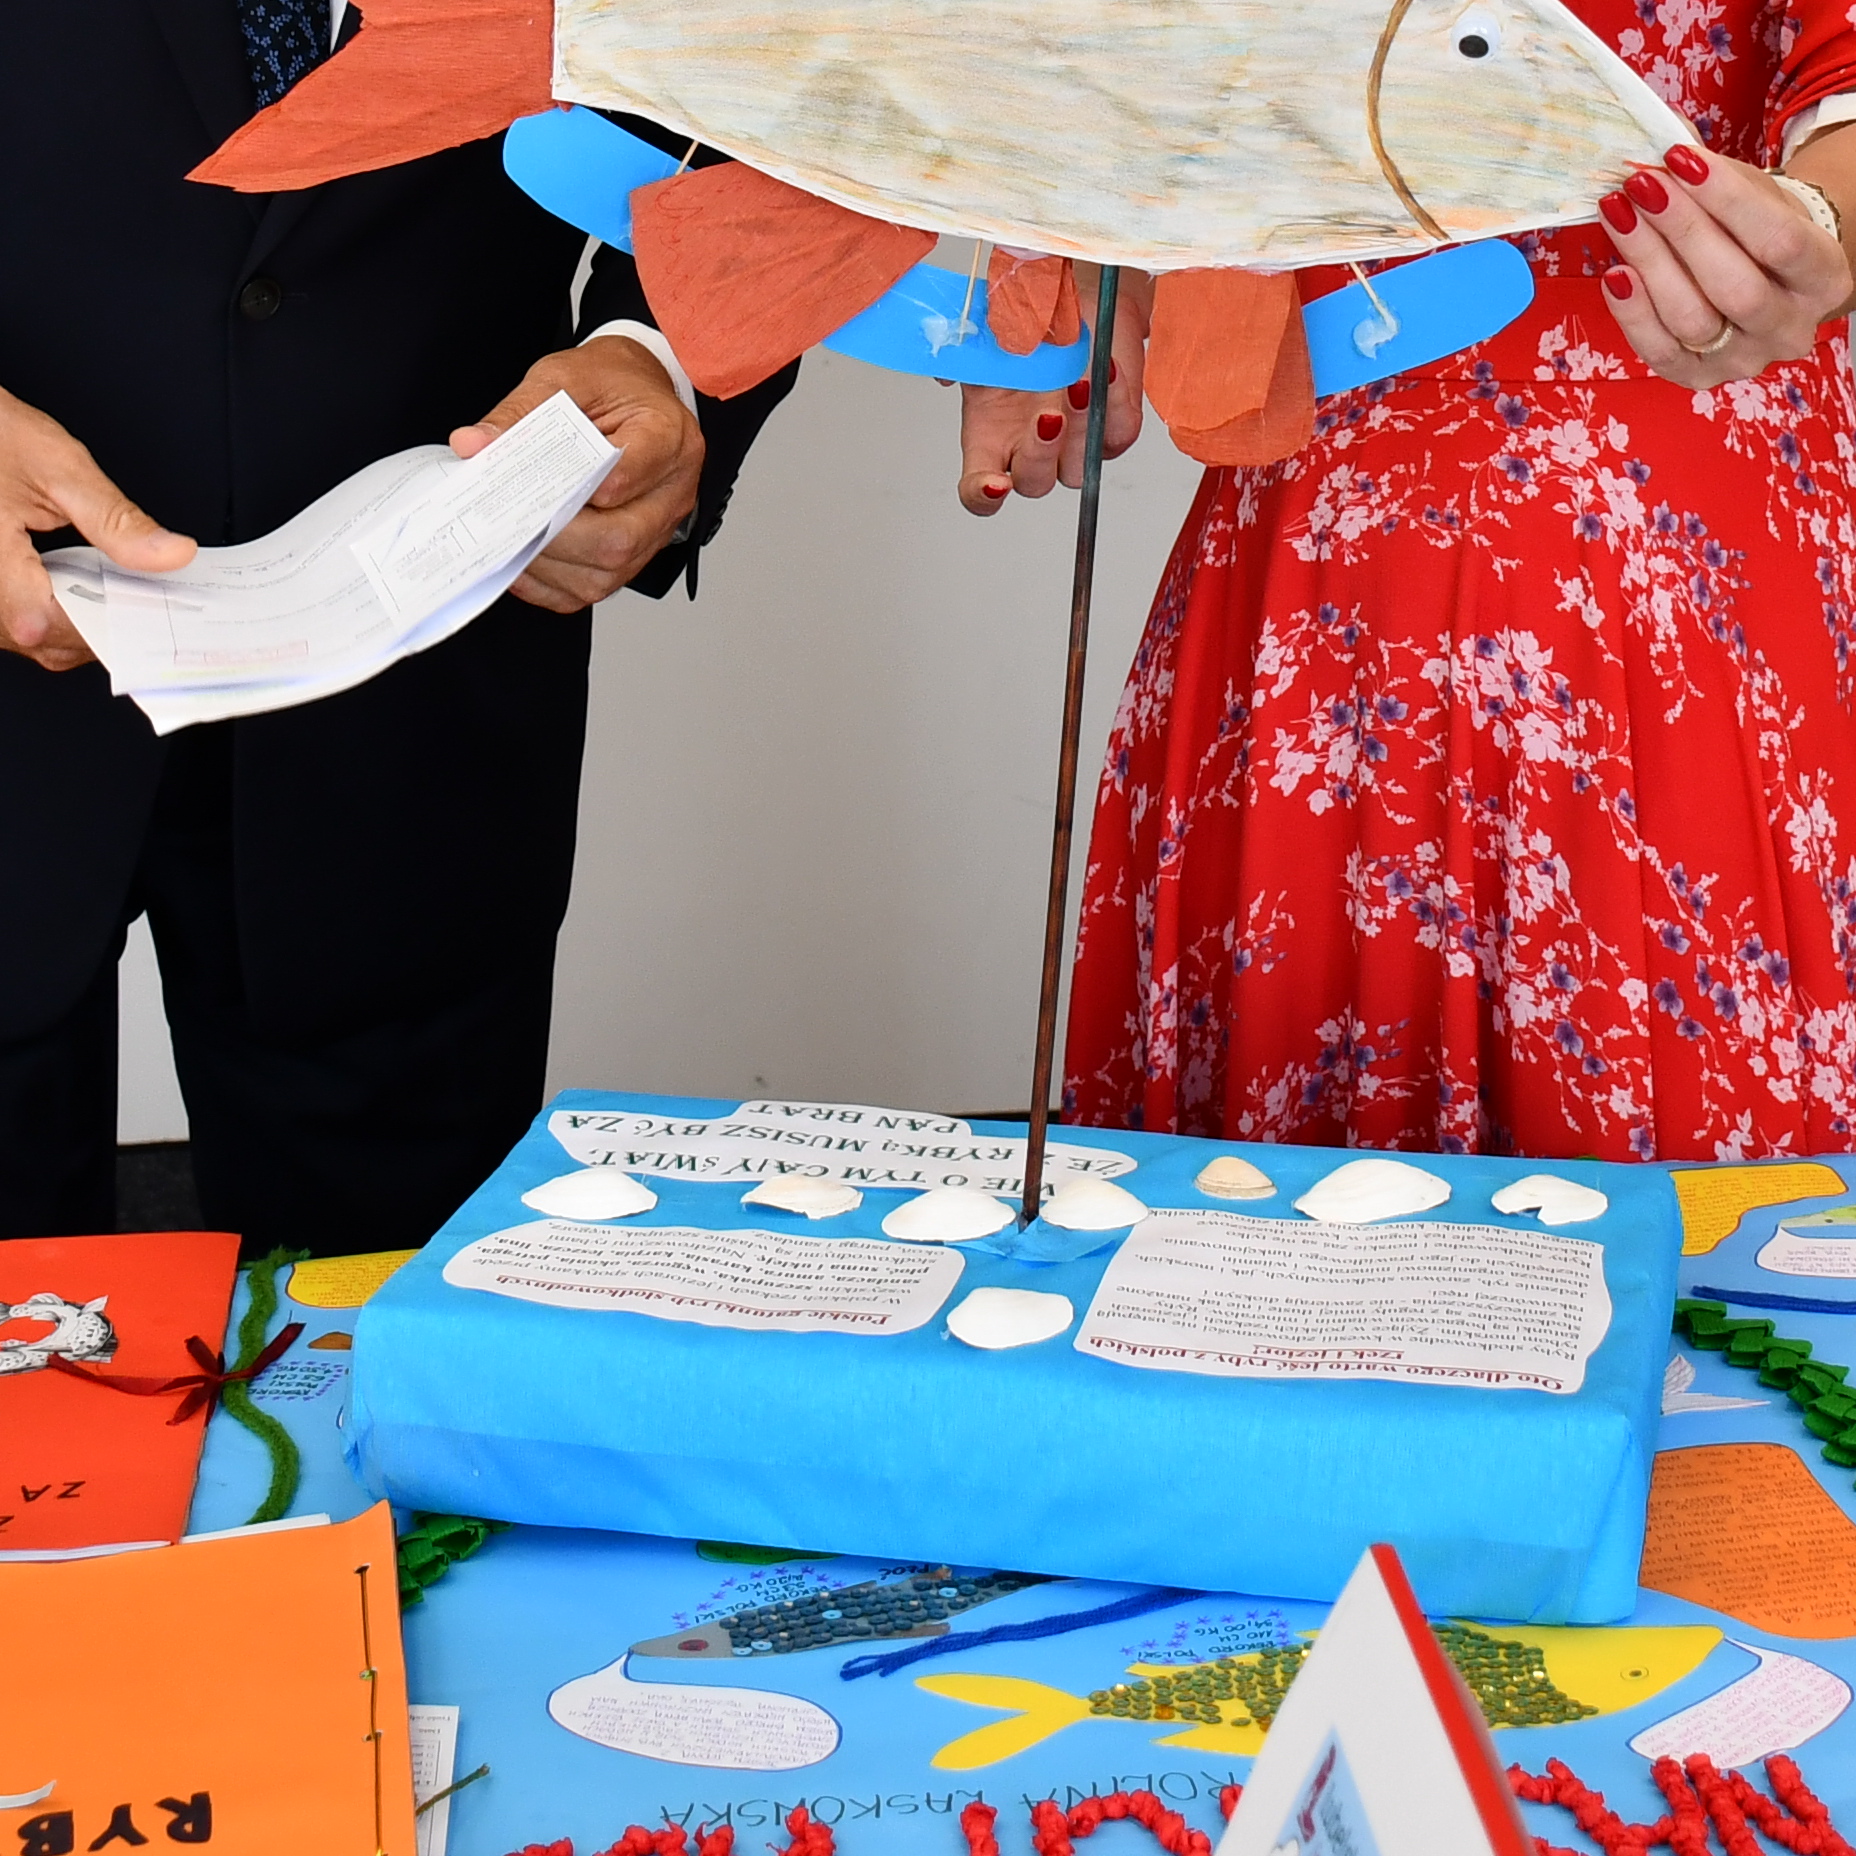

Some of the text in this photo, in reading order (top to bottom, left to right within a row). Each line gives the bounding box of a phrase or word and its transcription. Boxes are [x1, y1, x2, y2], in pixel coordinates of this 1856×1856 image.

[567, 1115, 625, 1132] ZA
[748, 1104, 958, 1134] PAN BRAT
[718, 1124, 869, 1152] MUSISZ
[840, 1166, 926, 1184] TYM
[1067, 1157, 1123, 1181] ŻE
[940, 1174, 968, 1186] O
[670, 1297, 708, 1307] ryb
[714, 1303, 802, 1318] gatunki
[808, 1312, 888, 1325] Polskie
[1172, 1320, 1196, 1328] nie
[1204, 1316, 1268, 1330] rzekach
[1275, 1325, 1346, 1334] polskich
[1522, 1336, 1577, 1350] rybom
[1253, 1346, 1402, 1360] rzek jezior!
[1530, 1346, 1575, 1361] Ryby
[1090, 1338, 1562, 1390] Oto dlaczego warto jeść ryby z polskich
[18, 1480, 86, 1502] ZA
[735, 1581, 762, 1592] KG
[694, 1600, 756, 1624] POLSKI
[1194, 1626, 1218, 1636] KG
[1218, 1634, 1239, 1642] CM
[1138, 1640, 1276, 1658] REKORD POLSKI
[1019, 1771, 1234, 1813] ROLINA
